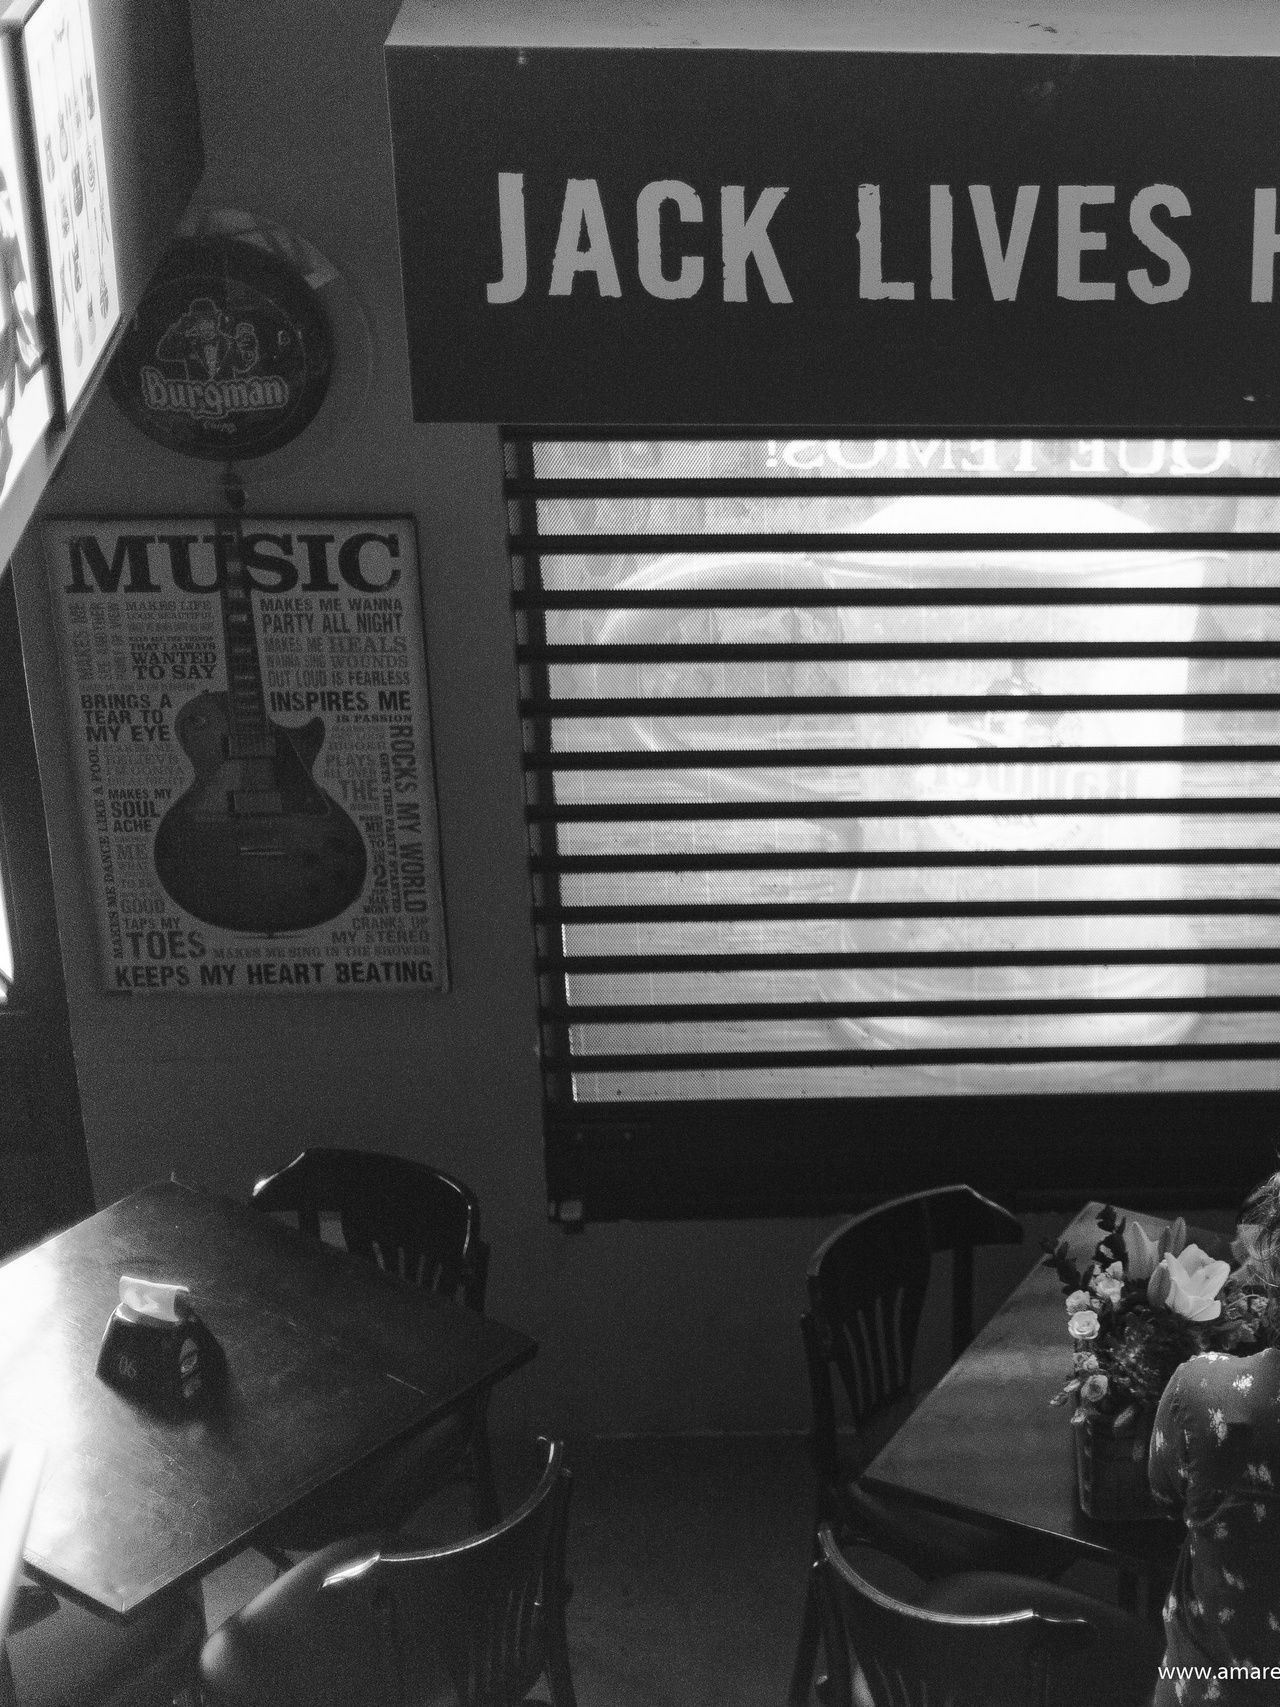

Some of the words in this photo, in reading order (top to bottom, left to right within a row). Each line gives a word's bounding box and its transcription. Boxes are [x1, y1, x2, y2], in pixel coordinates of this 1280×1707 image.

[487, 172, 794, 305] JACK
[856, 183, 1192, 305] LIVES
[143, 369, 284, 415] Burgman
[64, 532, 401, 594] MUSIC
[125, 601, 176, 611] MAKES
[181, 601, 211, 611] LIFE
[260, 599, 313, 612] MAKES
[319, 599, 342, 611] ME
[348, 599, 403, 611] WANNA
[262, 613, 314, 633] PARTY
[322, 613, 350, 633] ALL
[357, 613, 402, 633] NIGHT
[130, 643, 159, 651] THAT
[328, 636, 407, 653] HEALS
[131, 651, 217, 665] WANTED
[330, 655, 408, 668] WOUNDS
[132, 665, 165, 680] TO
[172, 664, 217, 680] SAY
[268, 671, 290, 687] OUT
[296, 671, 327, 687] LOUD
[332, 671, 344, 685] IS
[348, 671, 410, 686] FEARLESS
[81, 693, 151, 709] BRINGS
[160, 693, 172, 709] A
[270, 691, 369, 711] INSPIRES
[378, 690, 412, 711] ME
[84, 709, 132, 725] TEAR
[140, 709, 163, 724] TO
[354, 715, 412, 723] PASSION
[86, 726, 121, 742] MY
[131, 725, 170, 742] EYE
[88, 745, 102, 783] FOOL
[325, 754, 376, 767] PLAYS
[390, 725, 418, 793] ROCKS
[380, 753, 391, 784] GETS
[93, 786, 103, 795] A
[108, 788, 149, 800] MAKES
[154, 788, 172, 799] MY
[338, 780, 379, 801] THE
[110, 801, 161, 818] SOUL
[382, 787, 393, 816] THIS
[94, 799, 108, 832] LIKE
[397, 803, 421, 834] MY
[113, 819, 153, 833] ACHE
[385, 819, 398, 857] PARTY
[99, 836, 114, 883] DANCE
[373, 865, 388, 888] 2
[399, 842, 428, 913] WORLD
[389, 860, 402, 913] STARTED
[105, 886, 117, 908] ME
[121, 898, 165, 914] GOOD
[122, 918, 156, 930] TAPS
[161, 917, 180, 930] MY
[352, 917, 404, 930] CRANKS
[411, 916, 428, 929] UP
[108, 911, 123, 959] MAKES
[332, 931, 357, 943] MY
[126, 931, 206, 960] TOES
[115, 965, 190, 987] KEEPS
[200, 964, 236, 986] MY
[247, 963, 325, 985] HEART
[335, 961, 433, 984] BEATING
